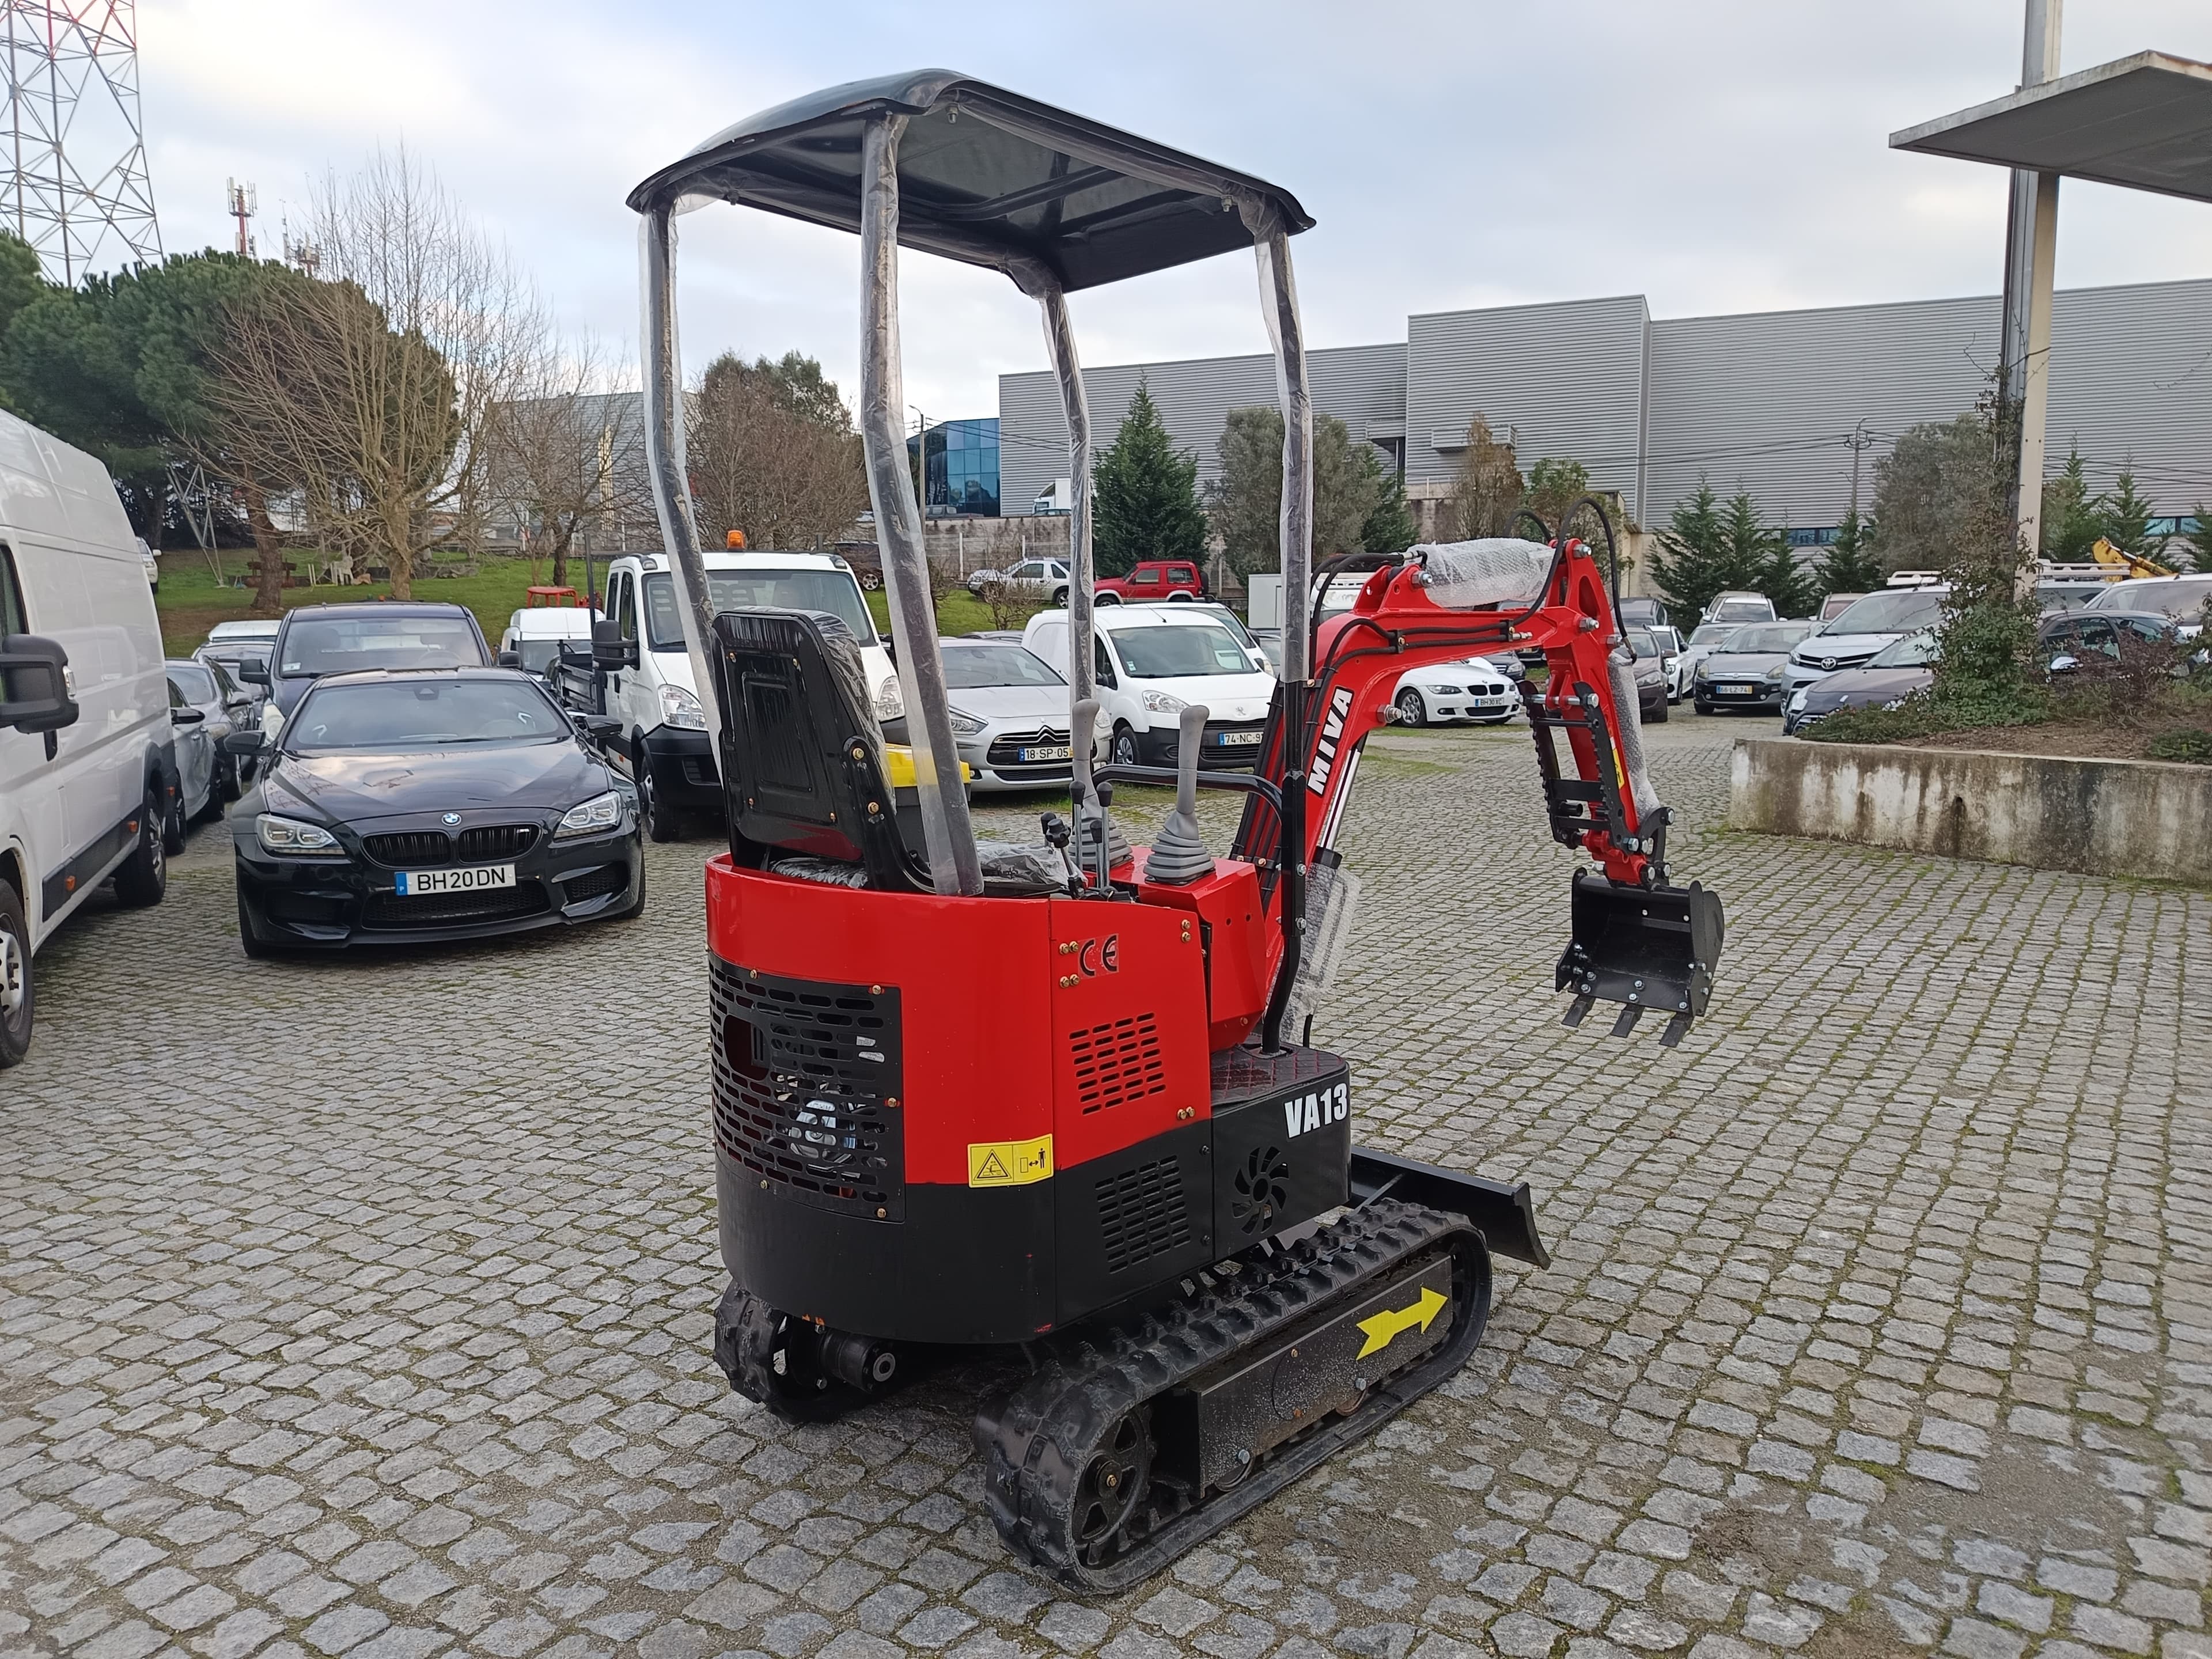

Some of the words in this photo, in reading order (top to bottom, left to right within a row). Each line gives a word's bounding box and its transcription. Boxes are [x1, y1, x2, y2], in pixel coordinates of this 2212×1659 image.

[1225, 733, 1263, 744] 74-NC-9
[1307, 688, 1353, 795] MIVA
[1080, 934, 1117, 976] CE
[1284, 1082, 1347, 1138] VA13
